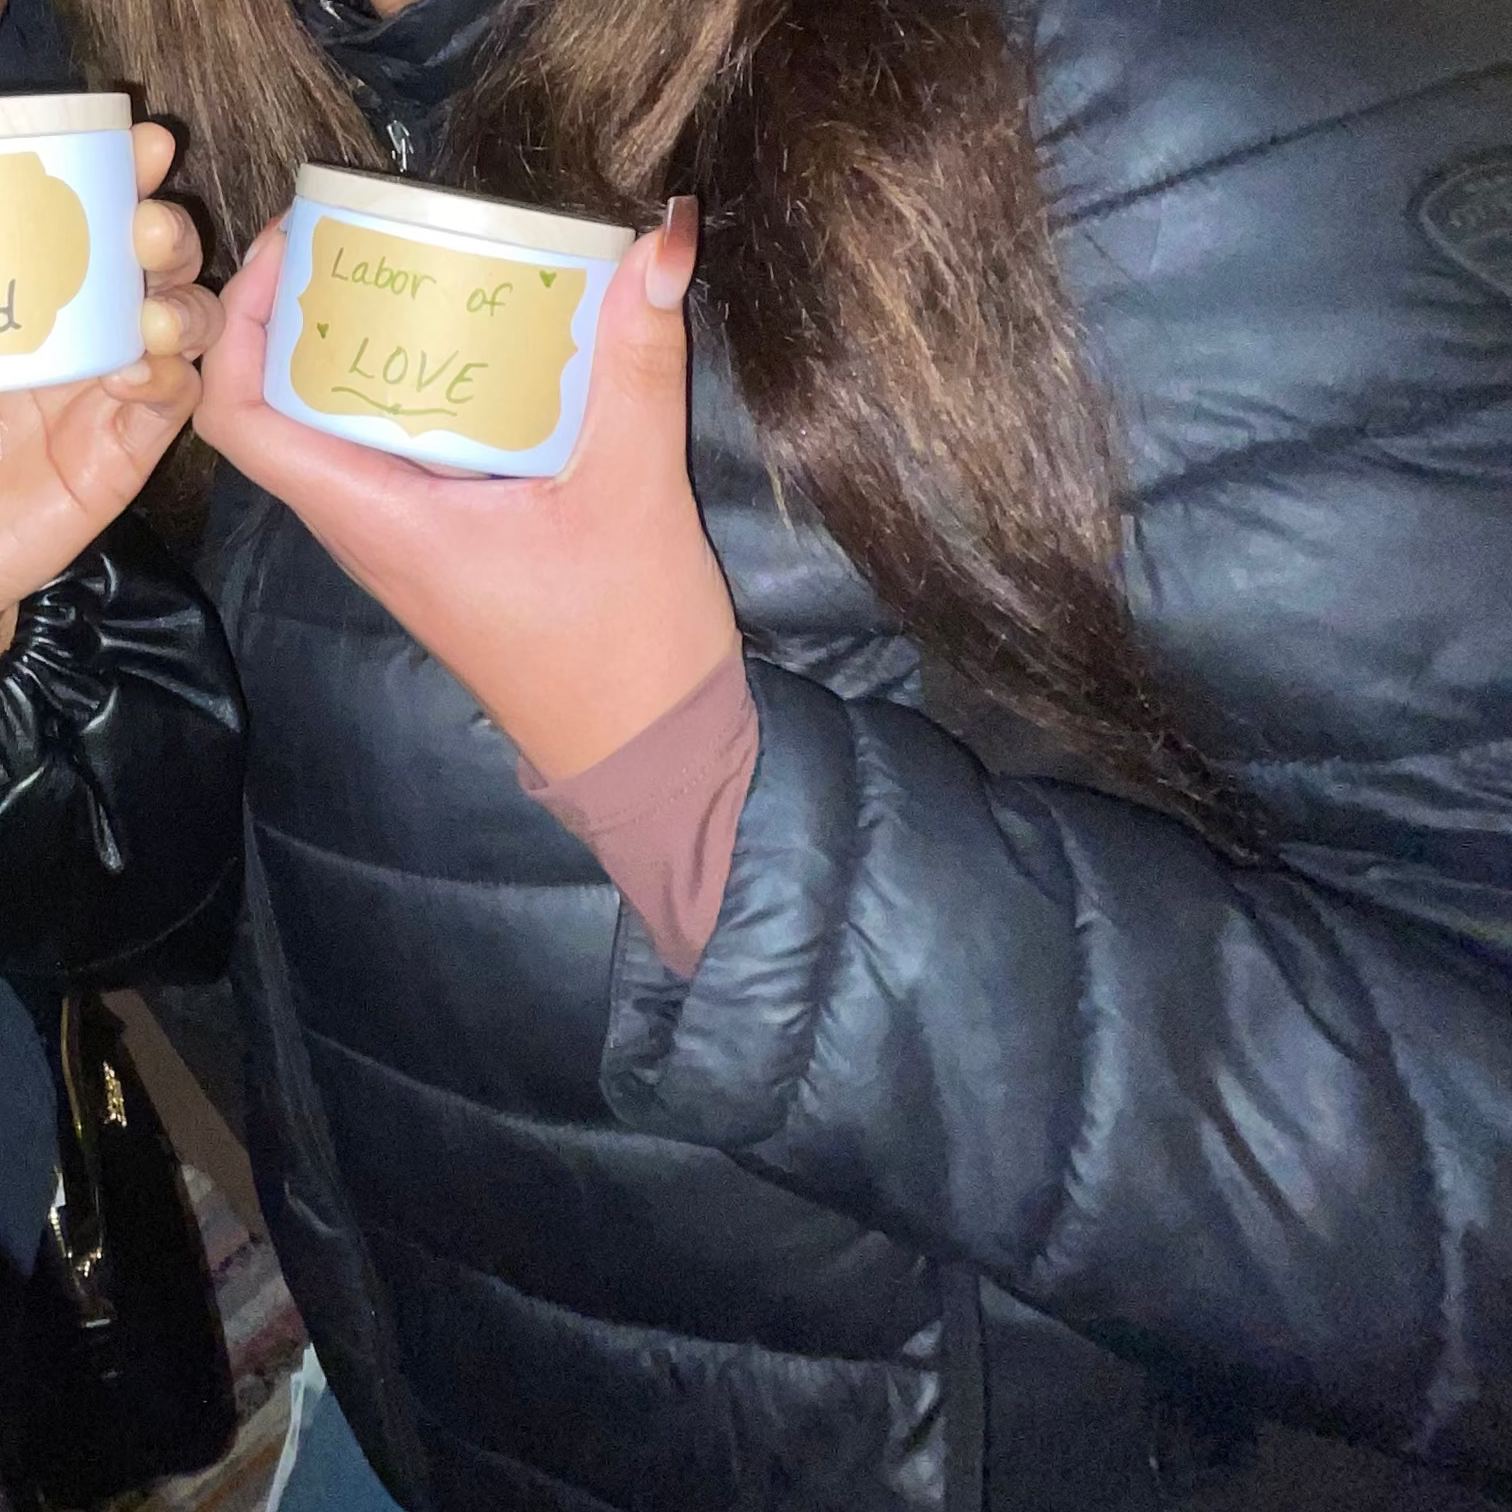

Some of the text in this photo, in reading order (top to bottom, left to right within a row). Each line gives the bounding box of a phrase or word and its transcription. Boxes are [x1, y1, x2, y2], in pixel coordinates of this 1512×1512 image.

[331, 246, 512, 318] Labor of
[348, 337, 489, 405] LOVE
